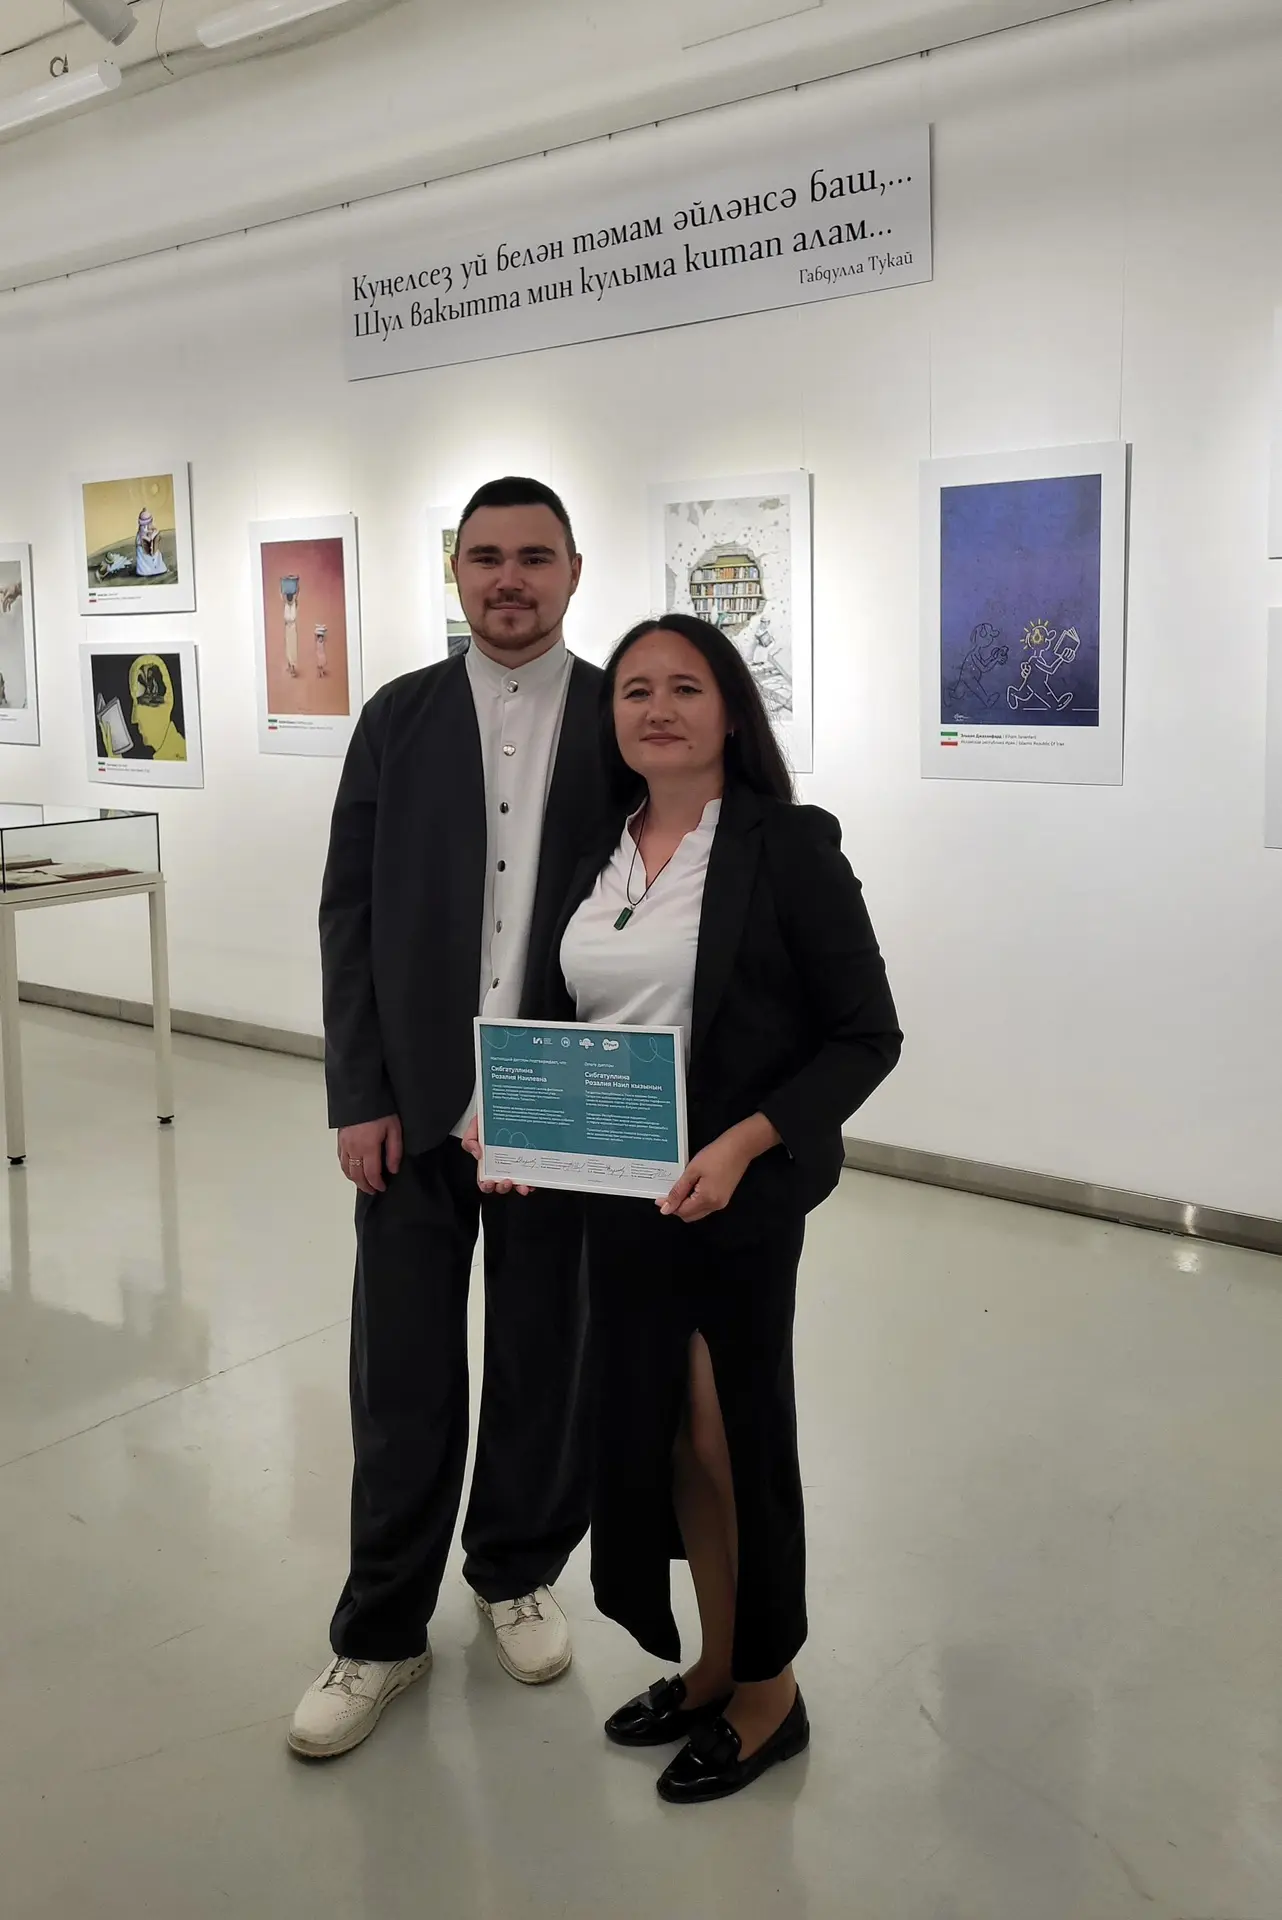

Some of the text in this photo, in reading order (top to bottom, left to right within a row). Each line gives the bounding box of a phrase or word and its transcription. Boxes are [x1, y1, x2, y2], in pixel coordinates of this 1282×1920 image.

[459, 253, 489, 290] уй
[497, 243, 565, 272] белән
[572, 216, 664, 255] тәмам
[673, 188, 797, 231] әйләнсә
[799, 251, 914, 285] Габдулла Тукай
[354, 219, 892, 342] Шул вакытта мин кулыма китап алам...
[491, 1065, 534, 1074] Сибгатуллина
[491, 1073, 548, 1083] Розалия Наилевна
[584, 1071, 630, 1081] Сибгатуллина
[613, 1081, 630, 1089] Наил
